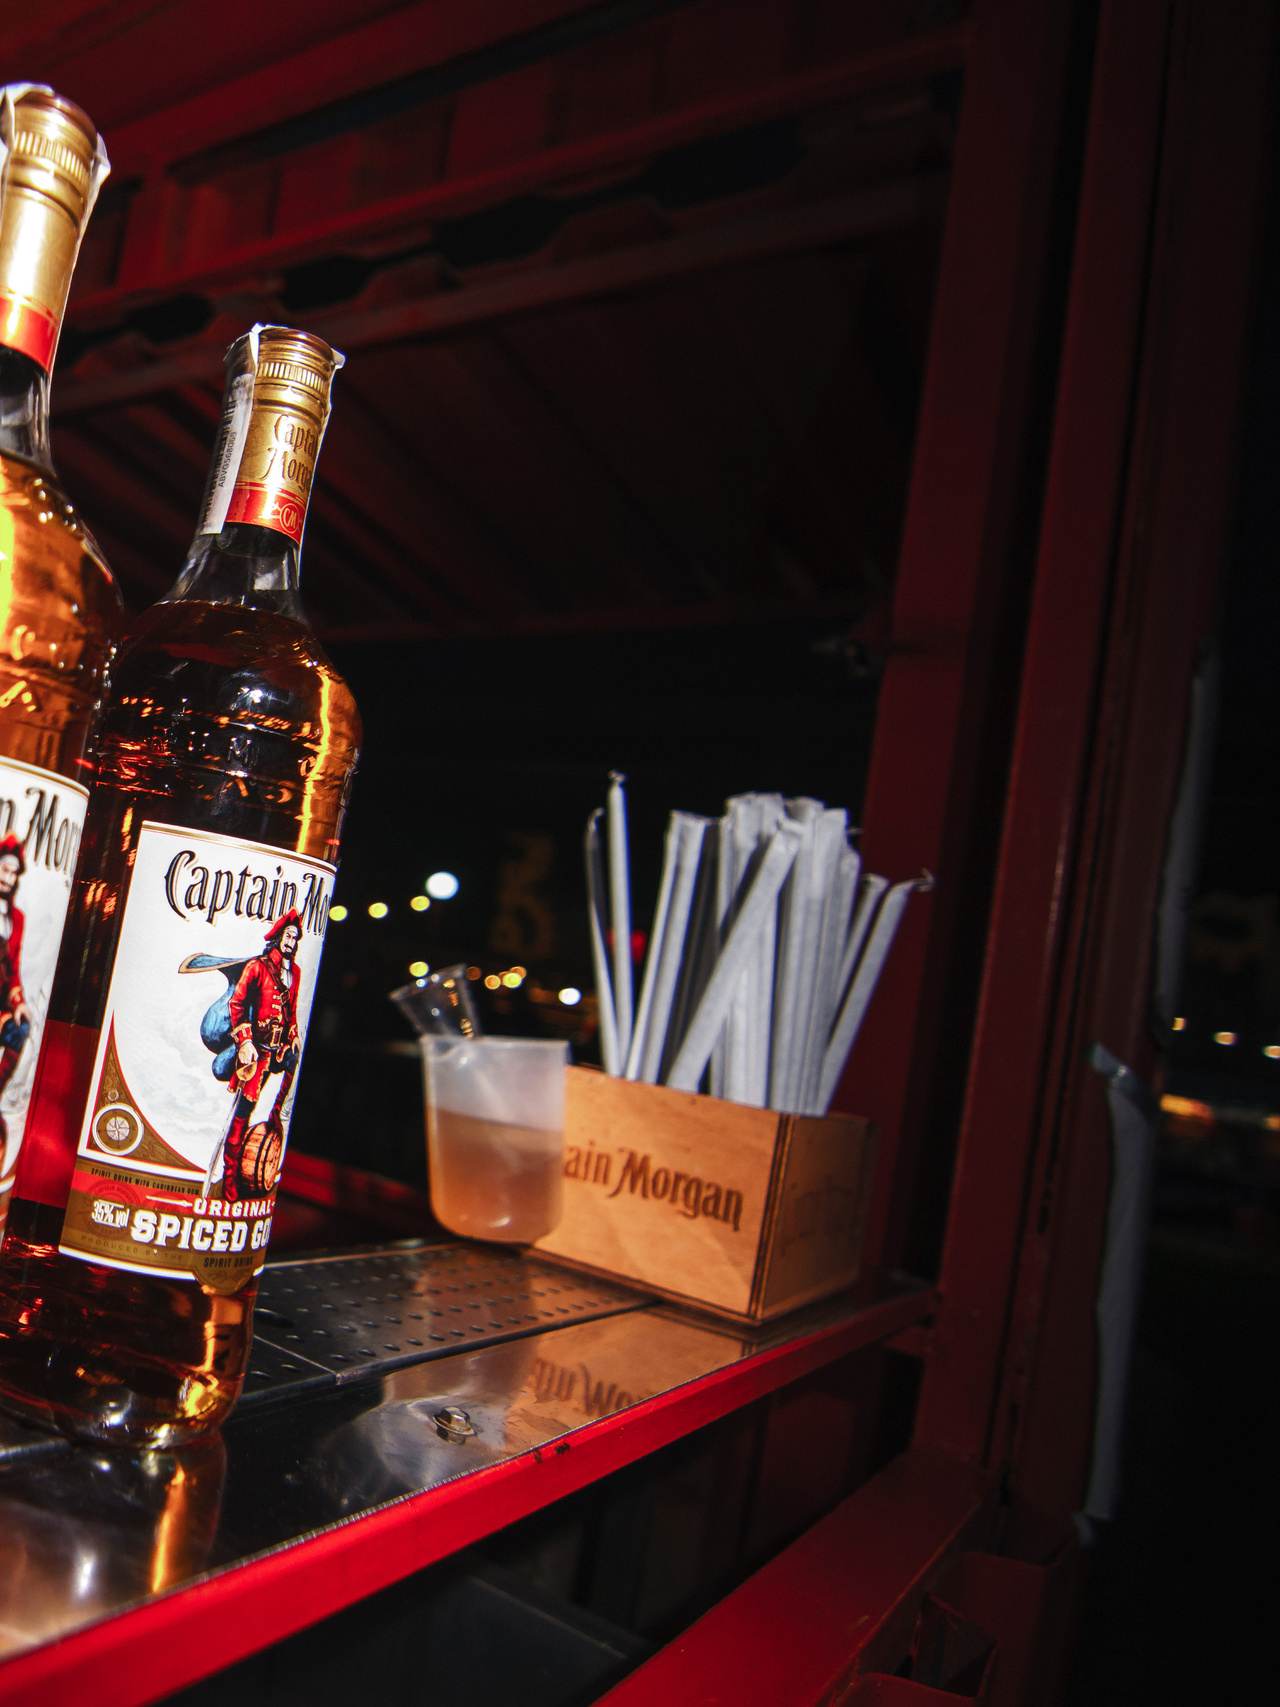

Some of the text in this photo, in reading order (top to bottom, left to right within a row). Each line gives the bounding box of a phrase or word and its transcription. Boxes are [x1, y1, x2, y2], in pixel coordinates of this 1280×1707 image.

[25, 786, 83, 890] Mor
[164, 849, 334, 938] Captain Mo
[91, 1168, 112, 1180] SPIRIT
[607, 1147, 744, 1232] Morgan
[193, 1198, 272, 1218] ORIGINAL
[81, 1234, 139, 1253] PRODUCED
[92, 1201, 115, 1226] 35%
[116, 1208, 131, 1228] vol
[130, 1209, 249, 1253] SPICED
[204, 1255, 253, 1268] SPIRIT DRINK
